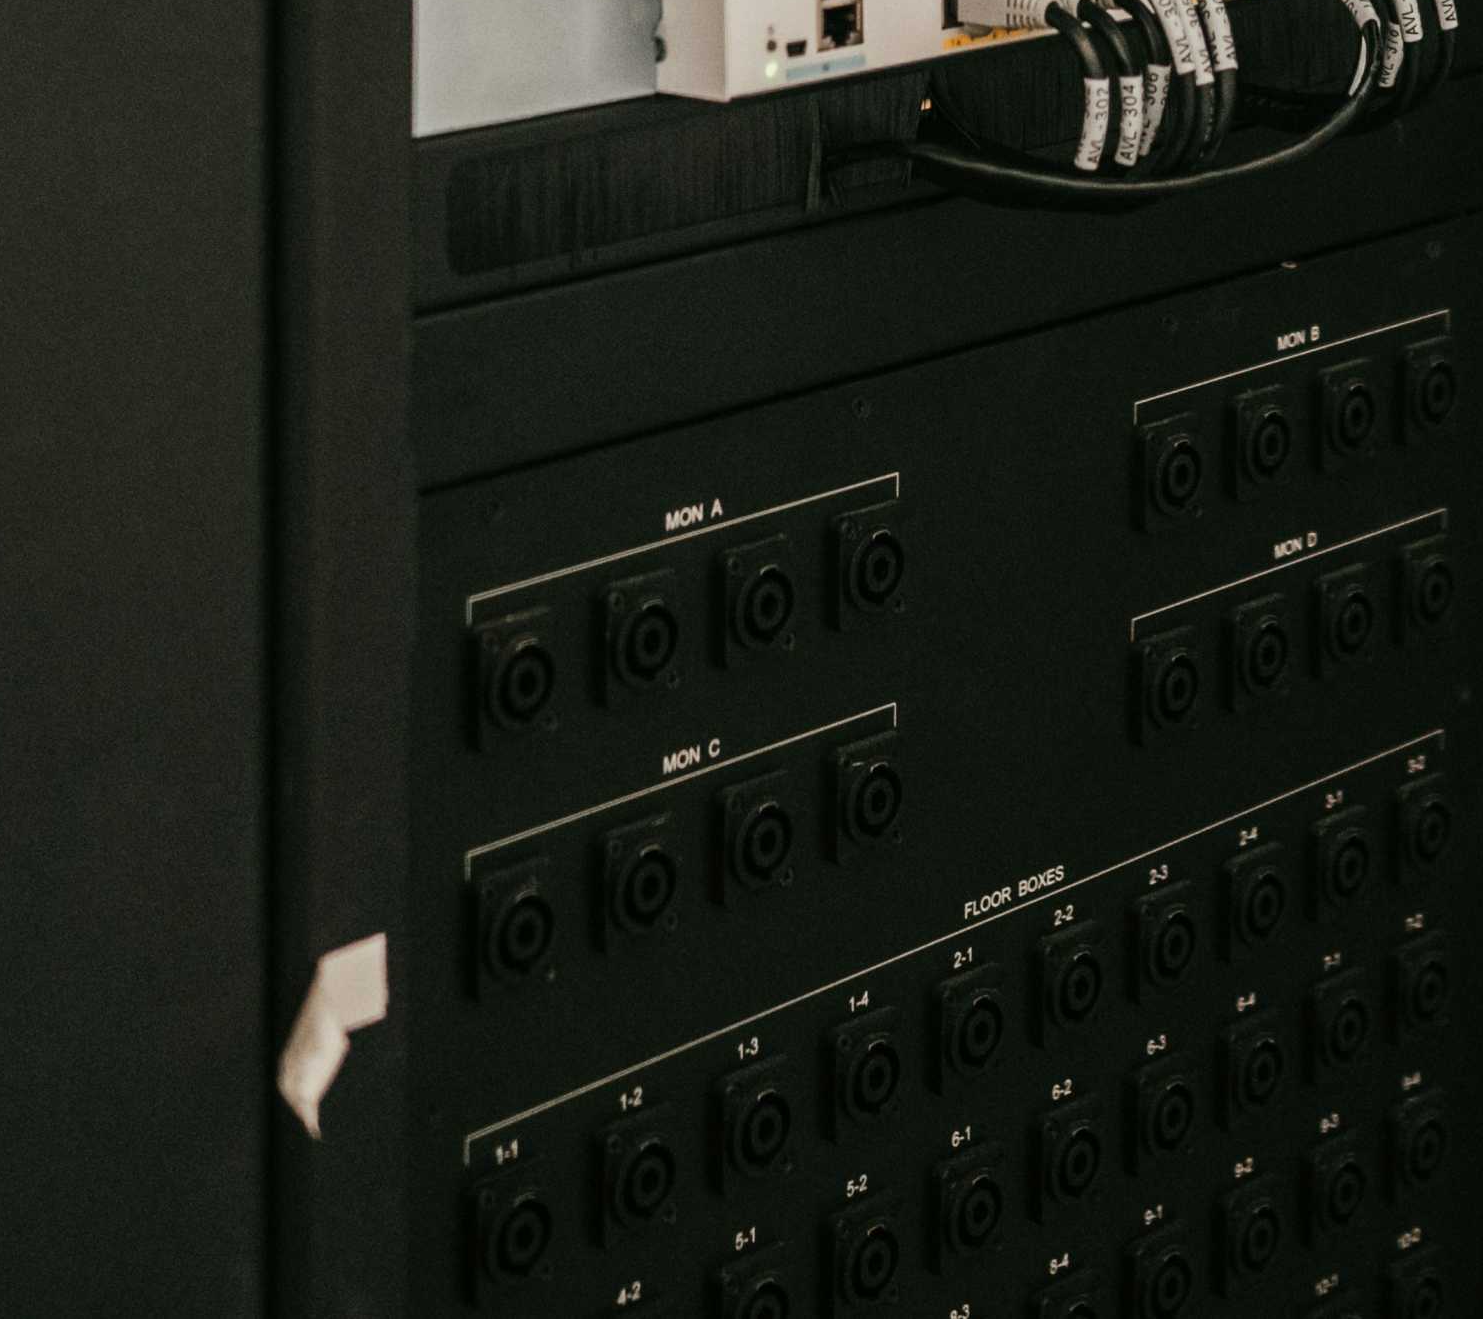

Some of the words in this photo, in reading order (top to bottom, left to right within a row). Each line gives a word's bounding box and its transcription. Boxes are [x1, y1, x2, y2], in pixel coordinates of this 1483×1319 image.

[1120, 84, 1138, 161] AVL-304
[1277, 329, 1306, 351] MON
[1310, 325, 1320, 342] B
[664, 502, 704, 532] MON
[710, 498, 723, 519] A
[1273, 536, 1303, 560] MON
[1307, 531, 1318, 548] D
[662, 743, 701, 775] MON
[708, 737, 721, 758] C
[963, 886, 1012, 920] FLOOR
[1018, 864, 1065, 898] BOXES
[495, 1139, 519, 1164] 1-1
[619, 1086, 643, 1110] 1-2
[737, 1036, 759, 1060] 1-3
[849, 990, 869, 1012] 1-4
[953, 946, 973, 969] 2-1
[1054, 904, 1074, 926] 2-2
[1149, 864, 1169, 886] 2-3
[1239, 826, 1258, 847] 2-4
[617, 1281, 642, 1305] 4-2
[735, 1226, 756, 1251] 5-1
[846, 1173, 868, 1198] 5-2
[951, 1125, 971, 1148] 6-1
[1051, 1078, 1072, 1101] 6-2
[1146, 1034, 1167, 1056] 6-3
[1049, 1253, 1069, 1275] 8-4
[1144, 1204, 1163, 1226] 9-1
